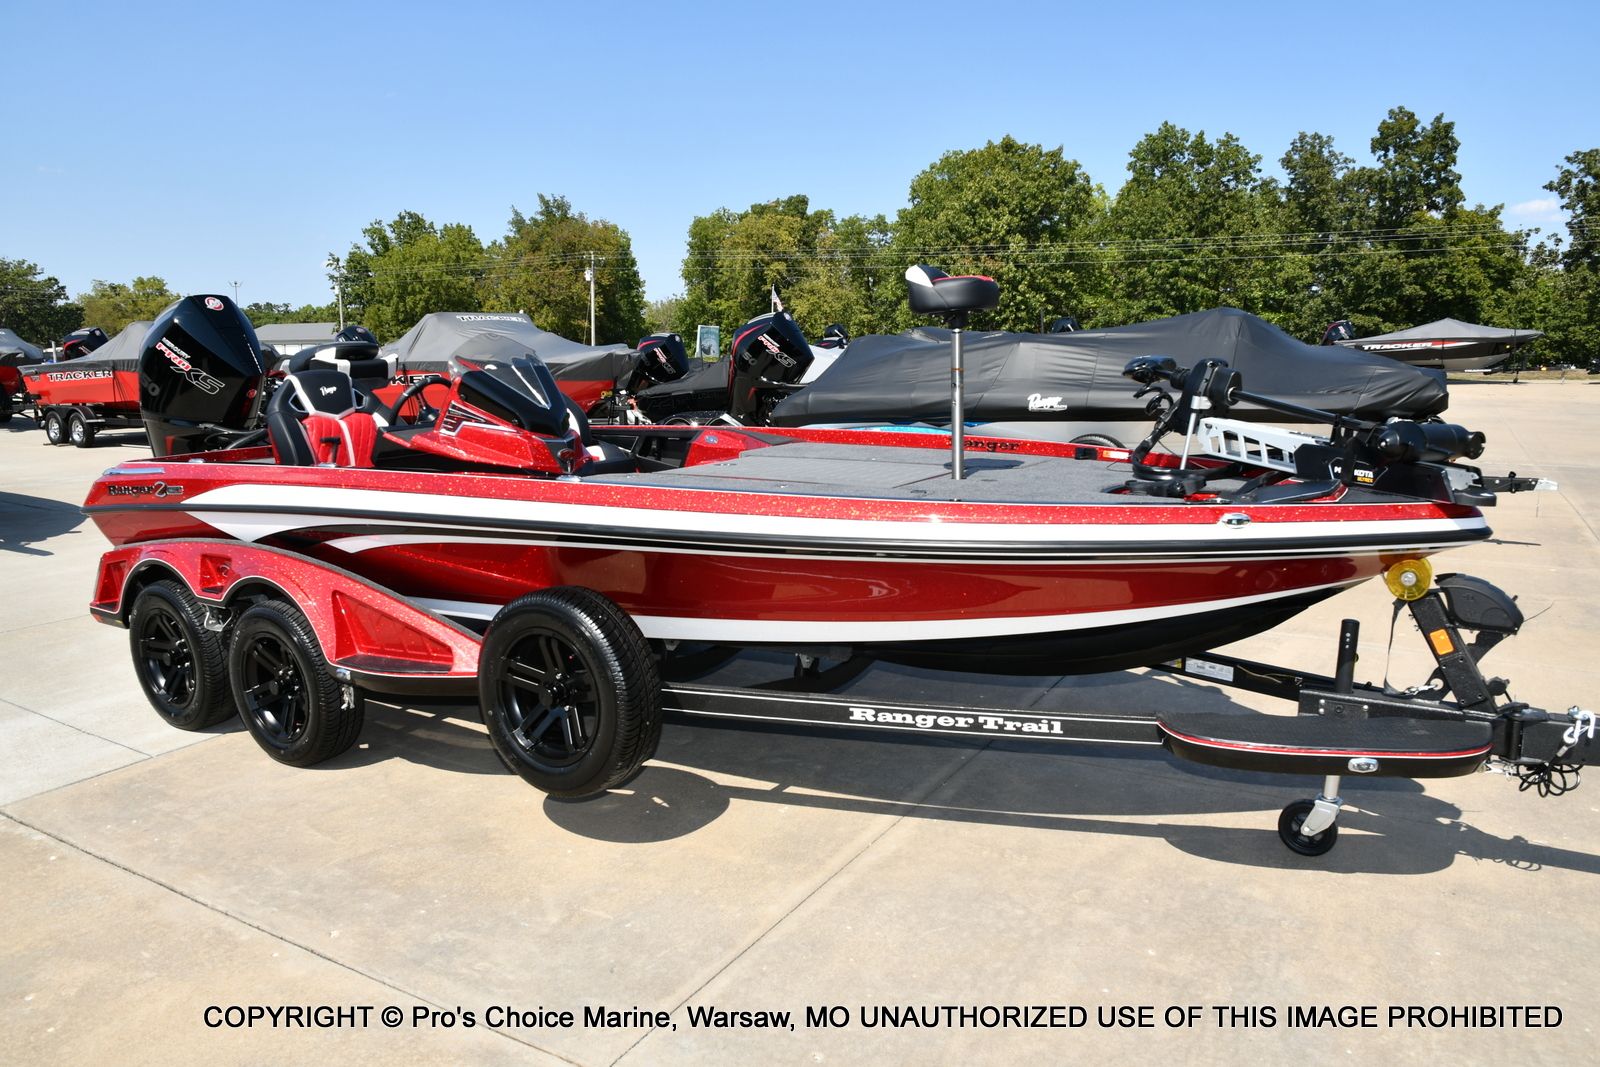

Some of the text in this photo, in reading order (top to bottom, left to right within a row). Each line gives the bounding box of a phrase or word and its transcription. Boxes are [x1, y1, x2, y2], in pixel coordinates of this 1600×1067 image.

[155, 342, 192, 371] PRO
[161, 336, 191, 359] MERCURY
[1362, 342, 1432, 351] TRACKER
[47, 370, 113, 382] TRACKER
[170, 365, 225, 395] XS
[849, 707, 1063, 734] Ranger Trail
